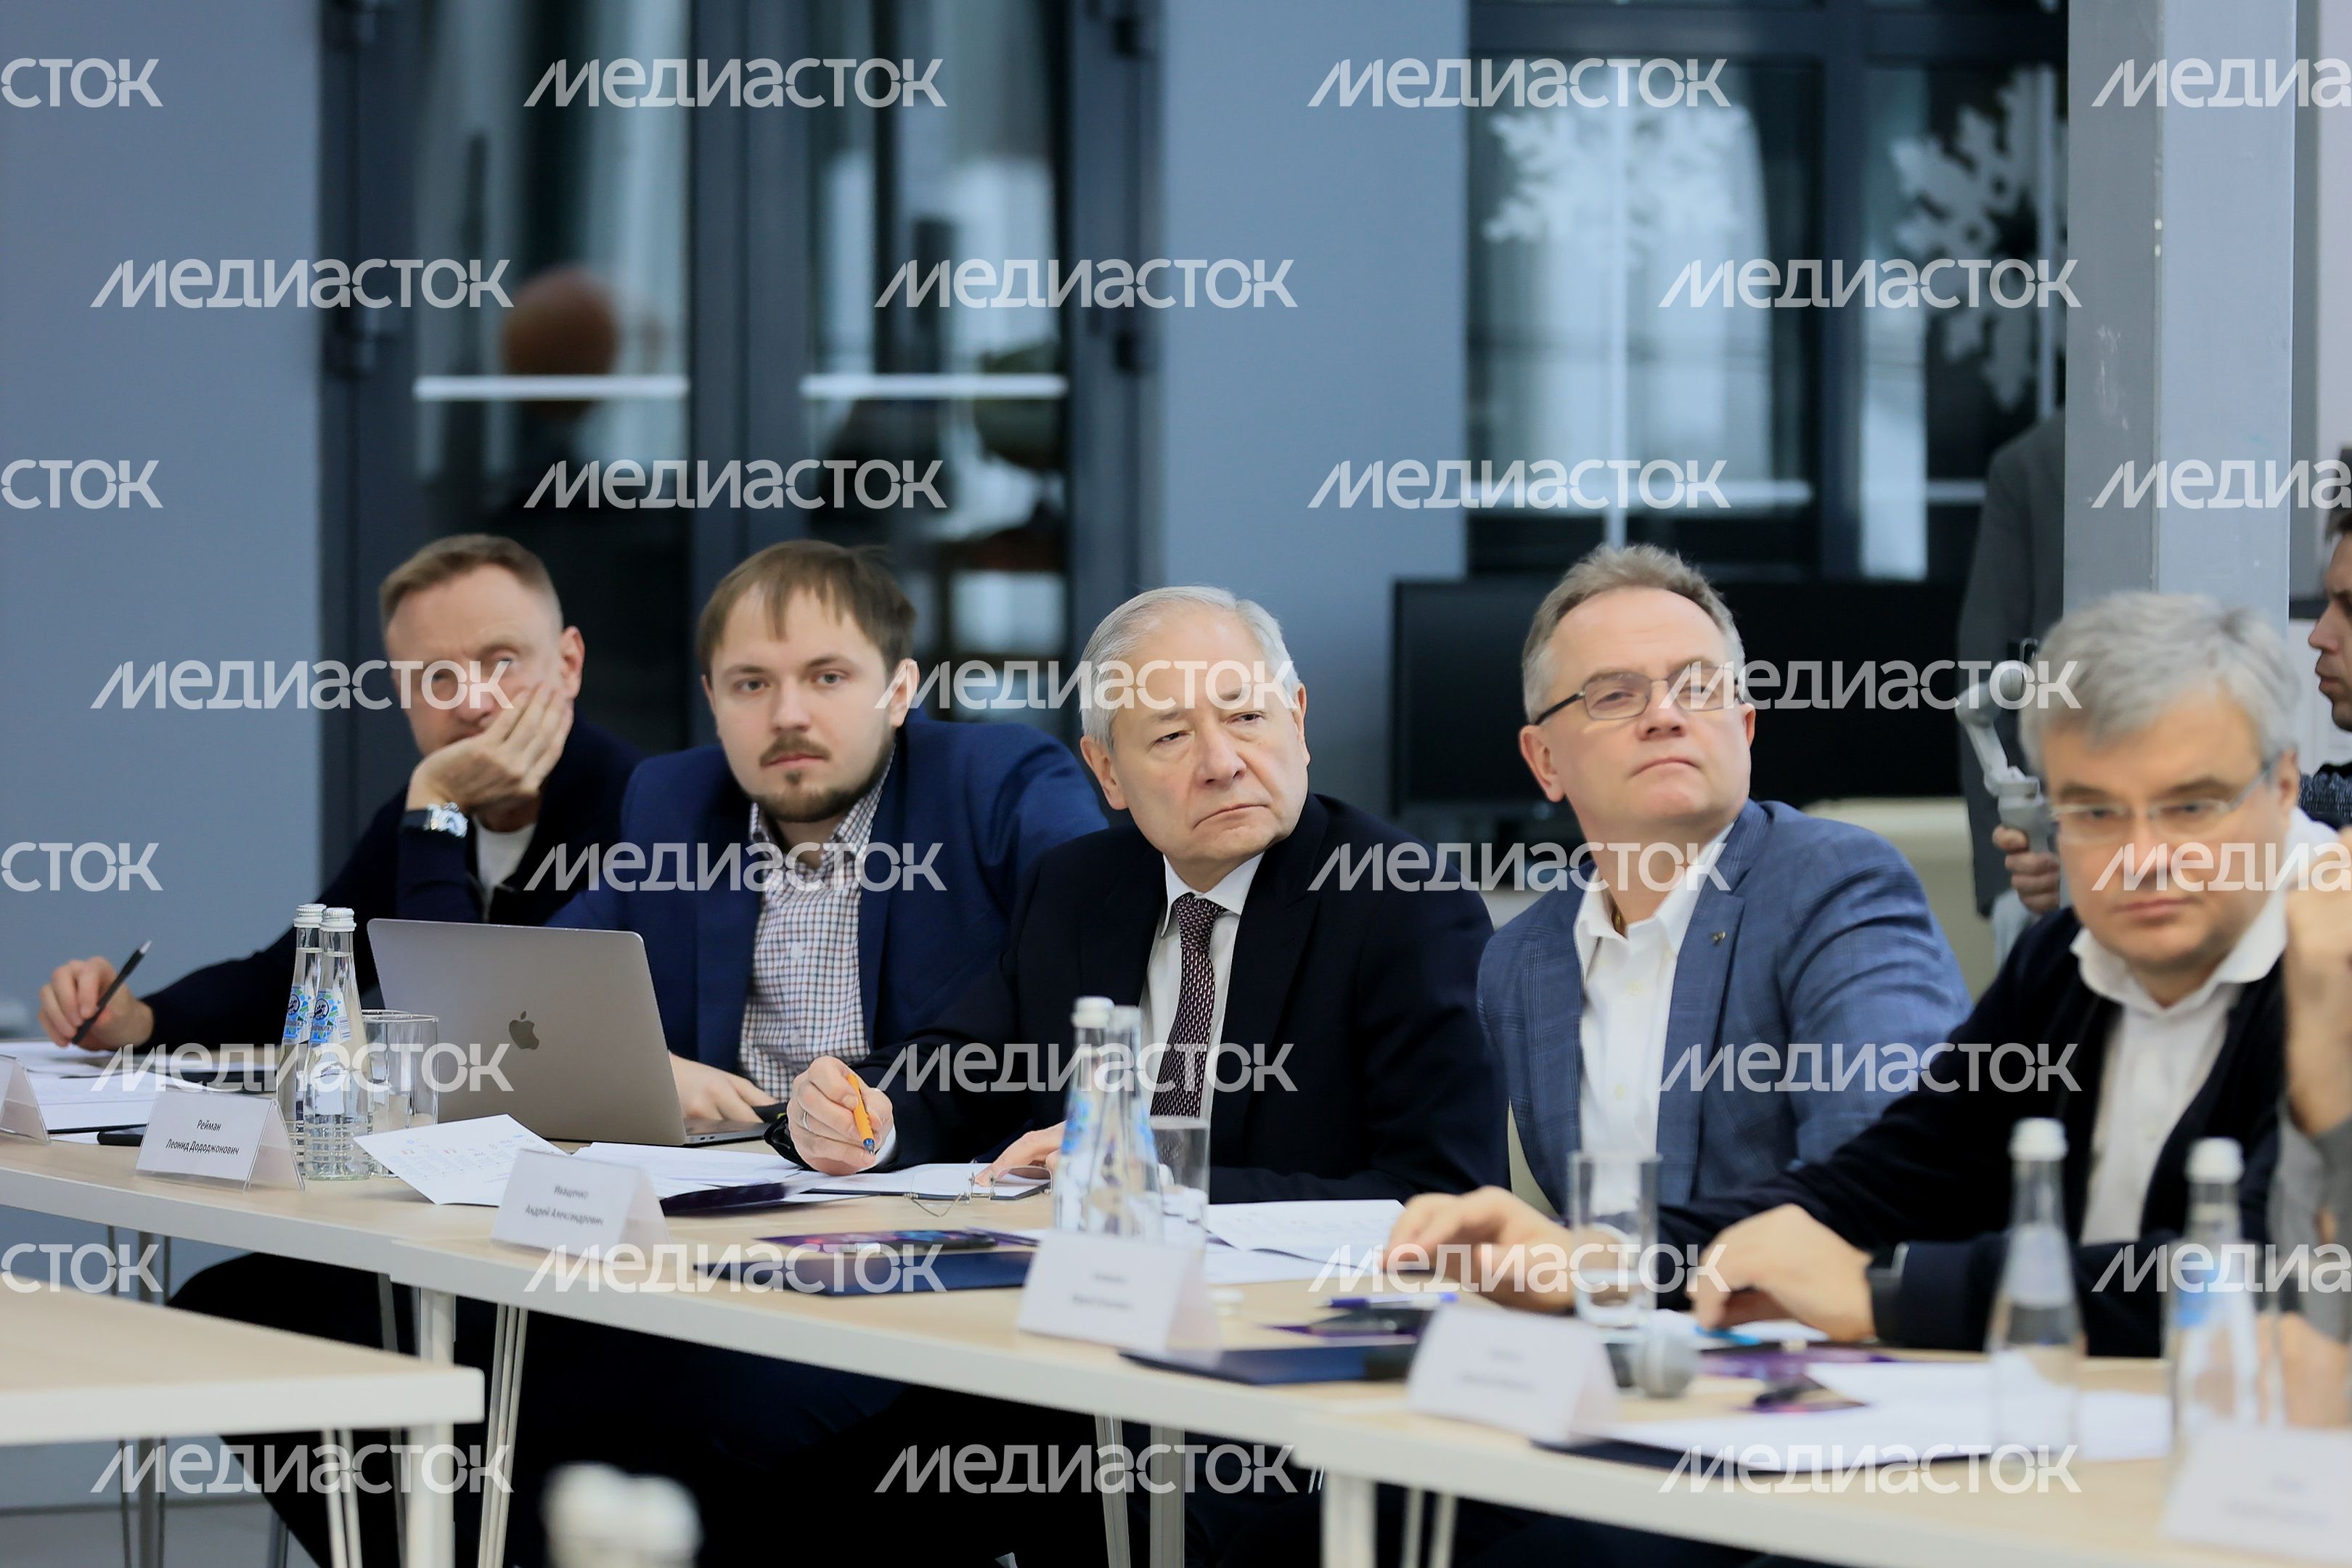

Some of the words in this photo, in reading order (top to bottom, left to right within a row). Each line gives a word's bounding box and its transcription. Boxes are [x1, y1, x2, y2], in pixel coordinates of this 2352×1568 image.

[197, 1119, 221, 1131] Рейман
[166, 1138, 189, 1151] Леонид
[190, 1140, 240, 1156] Дододжонович
[526, 1204, 550, 1217] Андрей
